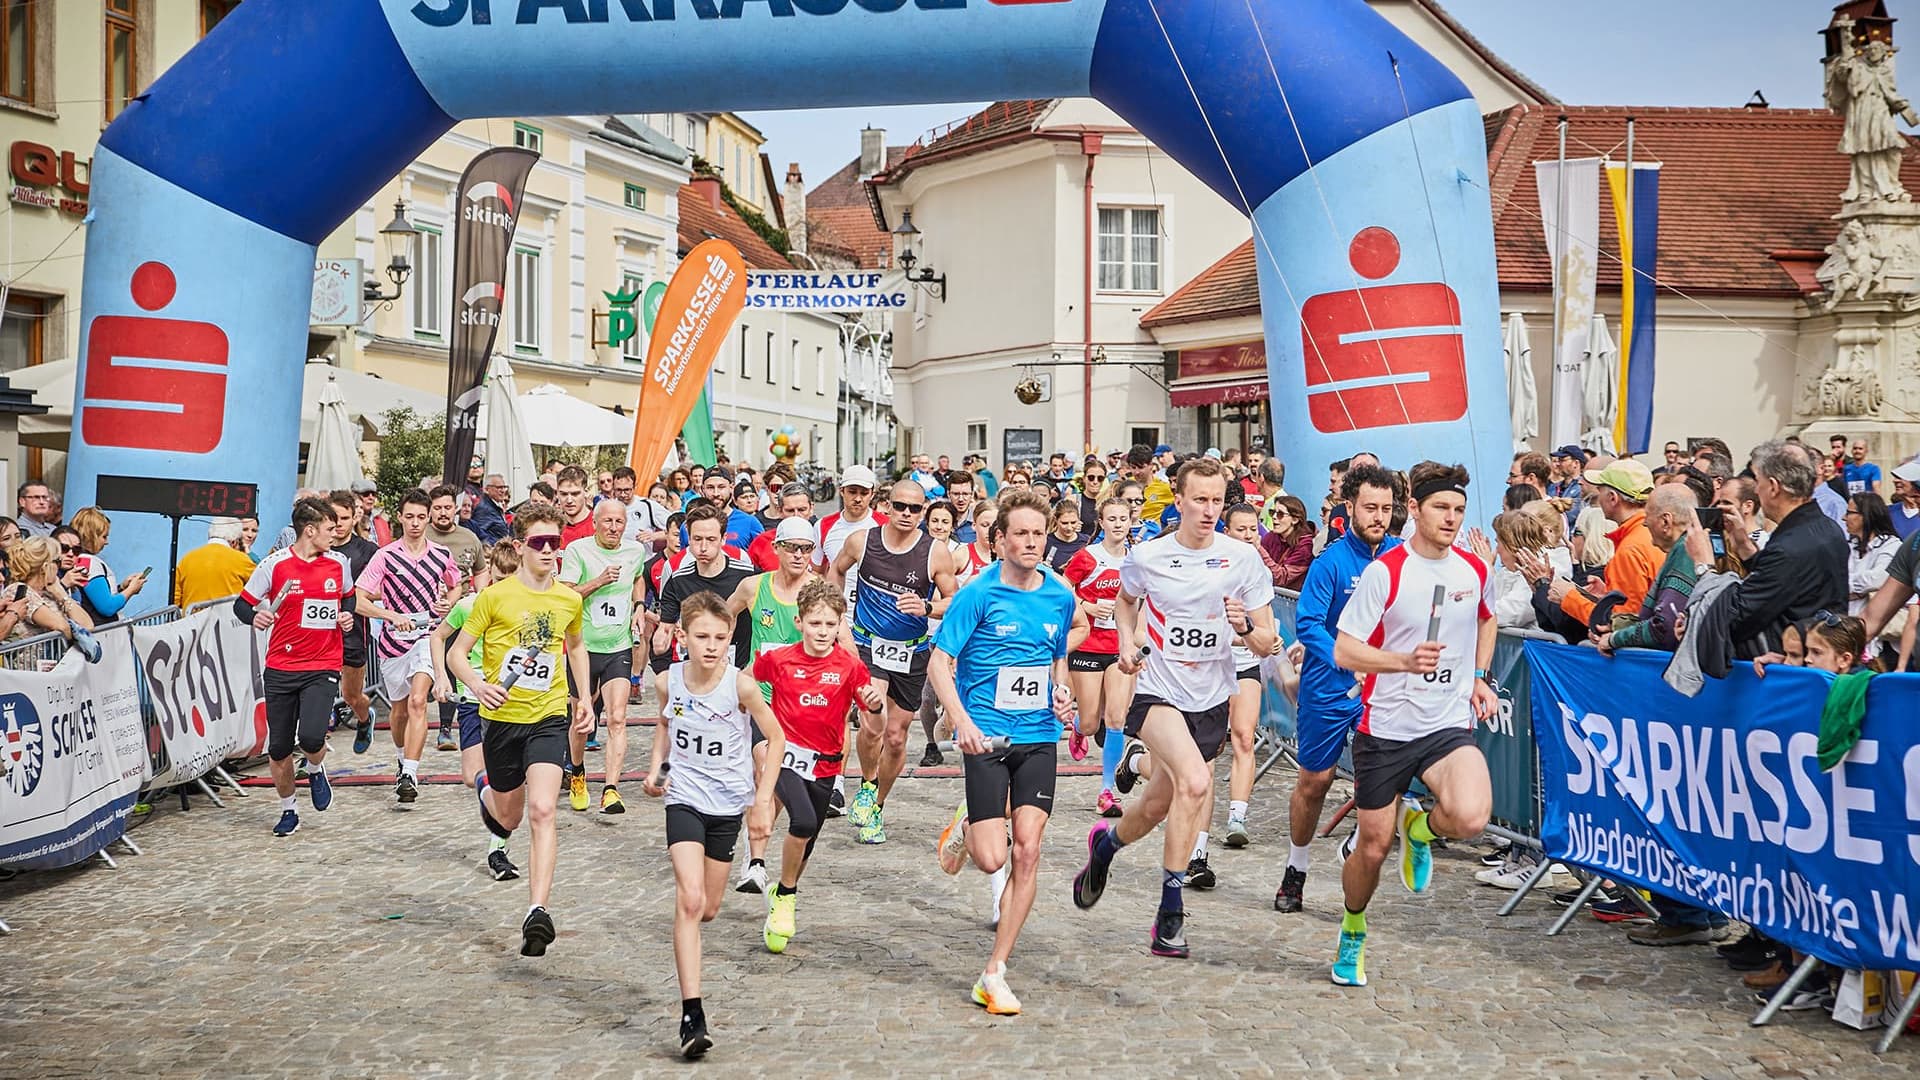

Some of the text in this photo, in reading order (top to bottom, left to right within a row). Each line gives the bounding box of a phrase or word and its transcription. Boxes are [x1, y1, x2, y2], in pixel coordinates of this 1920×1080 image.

[654, 276, 719, 388] SPARKASSE
[665, 270, 736, 396] Niederösterreich Mitte West
[600, 602, 616, 617] 1a
[1169, 626, 1217, 648] 38a
[874, 644, 909, 663] 42a
[1072, 659, 1099, 668] NIKE
[1011, 676, 1039, 697] 4a
[675, 728, 723, 757] 51a
[1558, 701, 1883, 865] SPARKASSE
